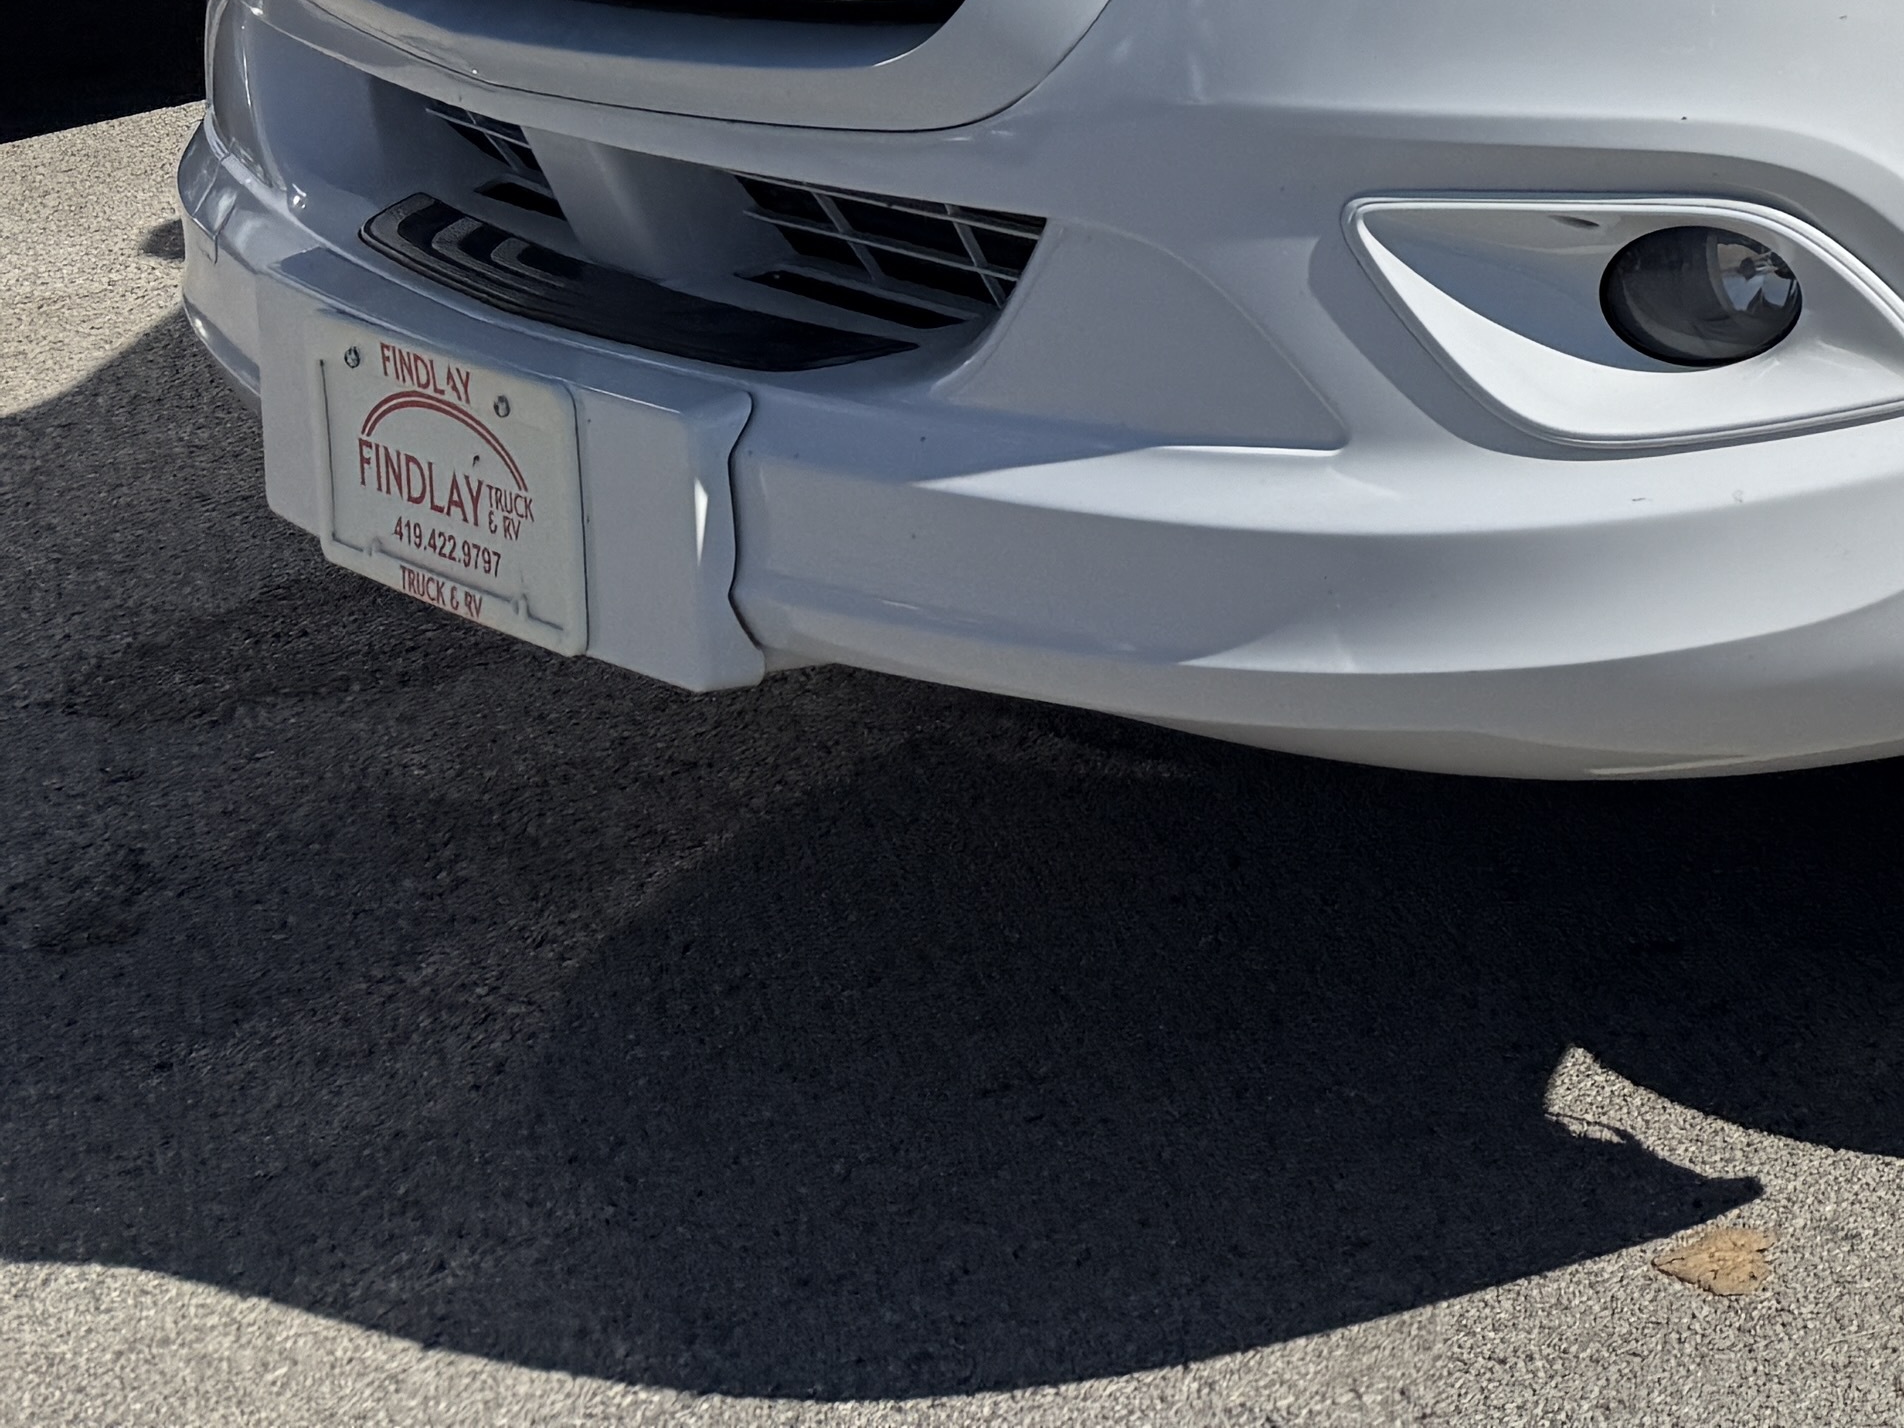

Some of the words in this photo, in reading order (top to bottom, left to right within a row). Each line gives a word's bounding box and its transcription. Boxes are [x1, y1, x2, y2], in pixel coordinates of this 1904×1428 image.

[379, 342, 471, 405] FINDLAY
[358, 437, 485, 527] FINDLAY
[486, 483, 535, 523] TRUCK
[393, 515, 502, 579] 419.422.9797
[503, 515, 522, 542] RV
[400, 564, 446, 607] TRUCK
[464, 589, 483, 620] RV
